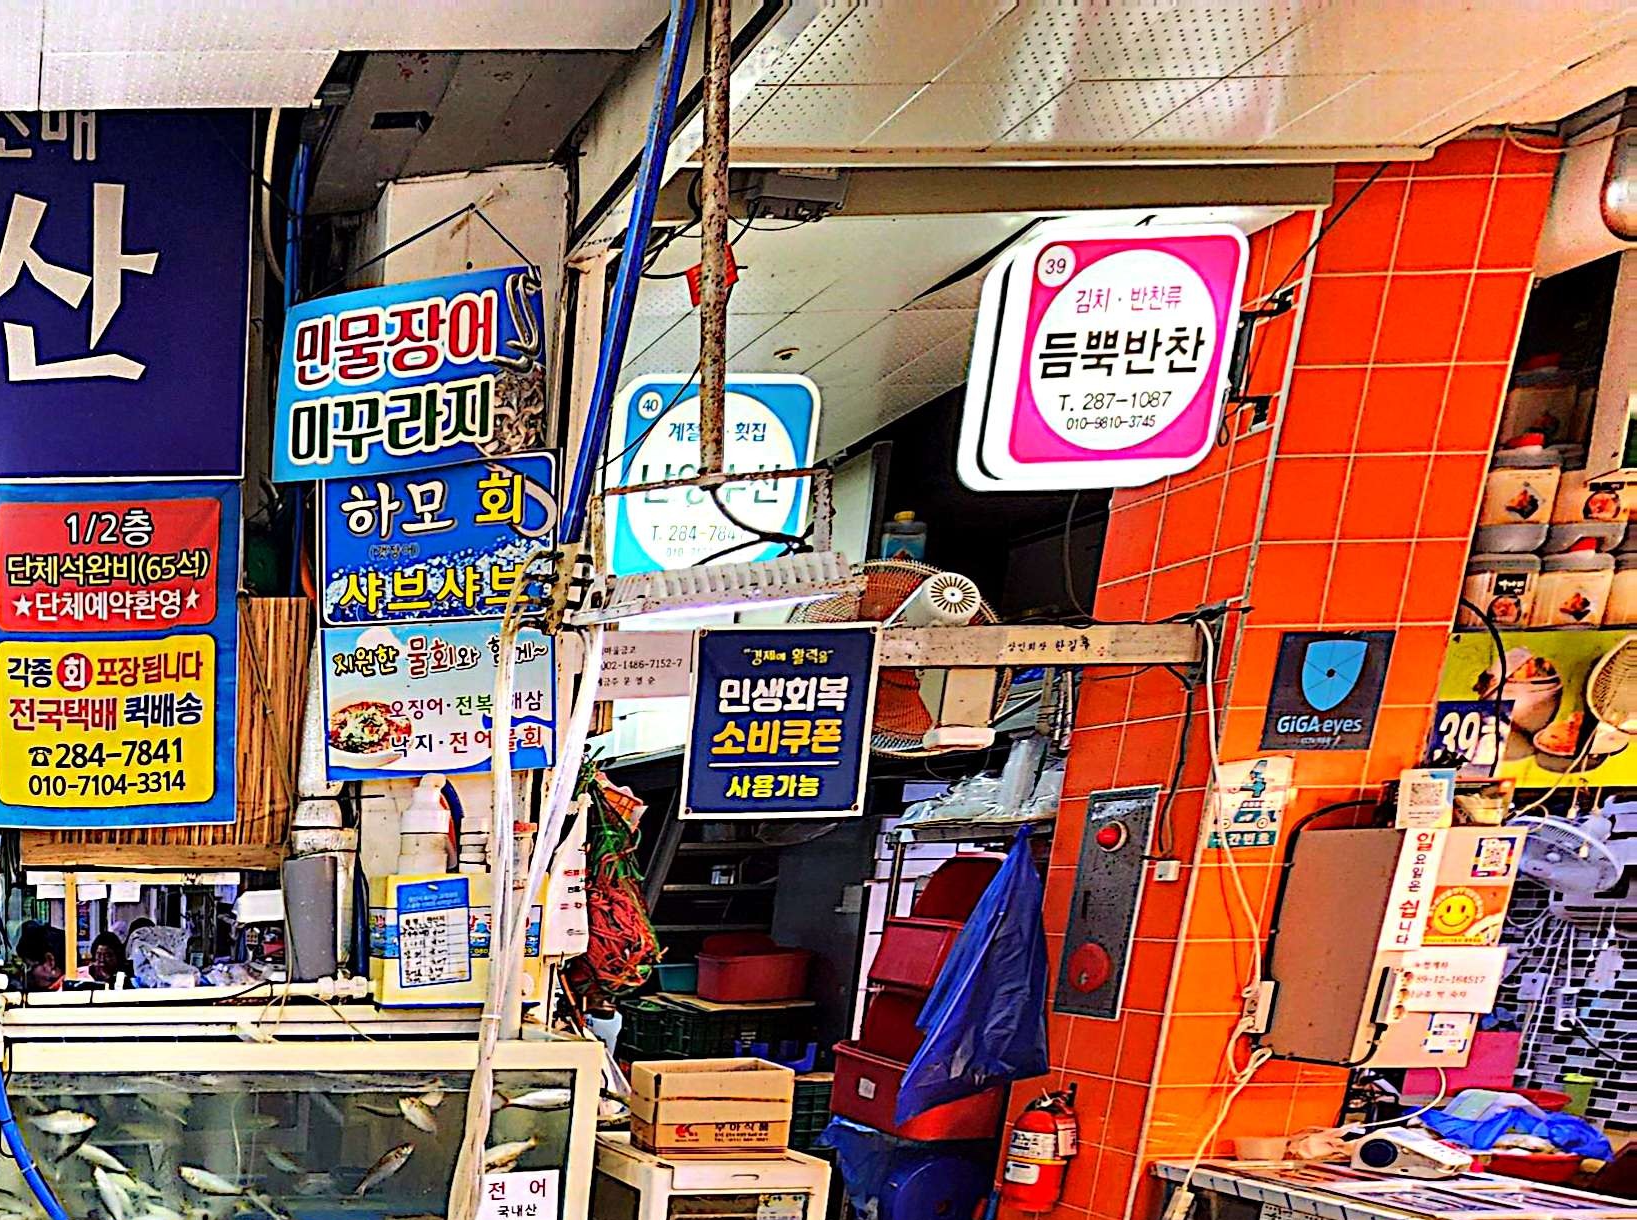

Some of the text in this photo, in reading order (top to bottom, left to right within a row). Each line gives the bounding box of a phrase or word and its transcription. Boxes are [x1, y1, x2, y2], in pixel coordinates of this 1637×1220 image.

[1045, 257, 1067, 275] 39
[1075, 286, 1183, 314] 김치 반찬류
[295, 292, 496, 388] 민물장어
[1038, 326, 1206, 380] 듬뿍반찬
[642, 398, 659, 413] 40
[1082, 390, 1173, 411] 287-1087
[290, 377, 493, 462] 미꾸라지
[734, 421, 767, 443] 횟집
[341, 473, 524, 539] 하모 회
[65, 508, 155, 547] 1/2층
[669, 524, 743, 541] 284-784
[7, 549, 211, 586] 단체석완비(65석)
[34, 588, 182, 621] 단체예약환영
[338, 564, 531, 614] 샤브샤브
[7, 649, 204, 689] 각종 회 포장됩니다
[406, 634, 482, 679] 물회와
[8, 691, 204, 732] 전국택배 퀵배송
[717, 675, 850, 714] 민생회복
[710, 718, 843, 755] 소비쿠폰
[1321, 718, 1363, 736] eyes
[54, 736, 184, 769] 284-7841
[28, 769, 186, 798] 010-7104-3314
[725, 773, 820, 799] 사용가능
[496, 1203, 538, 1218] 국내산
